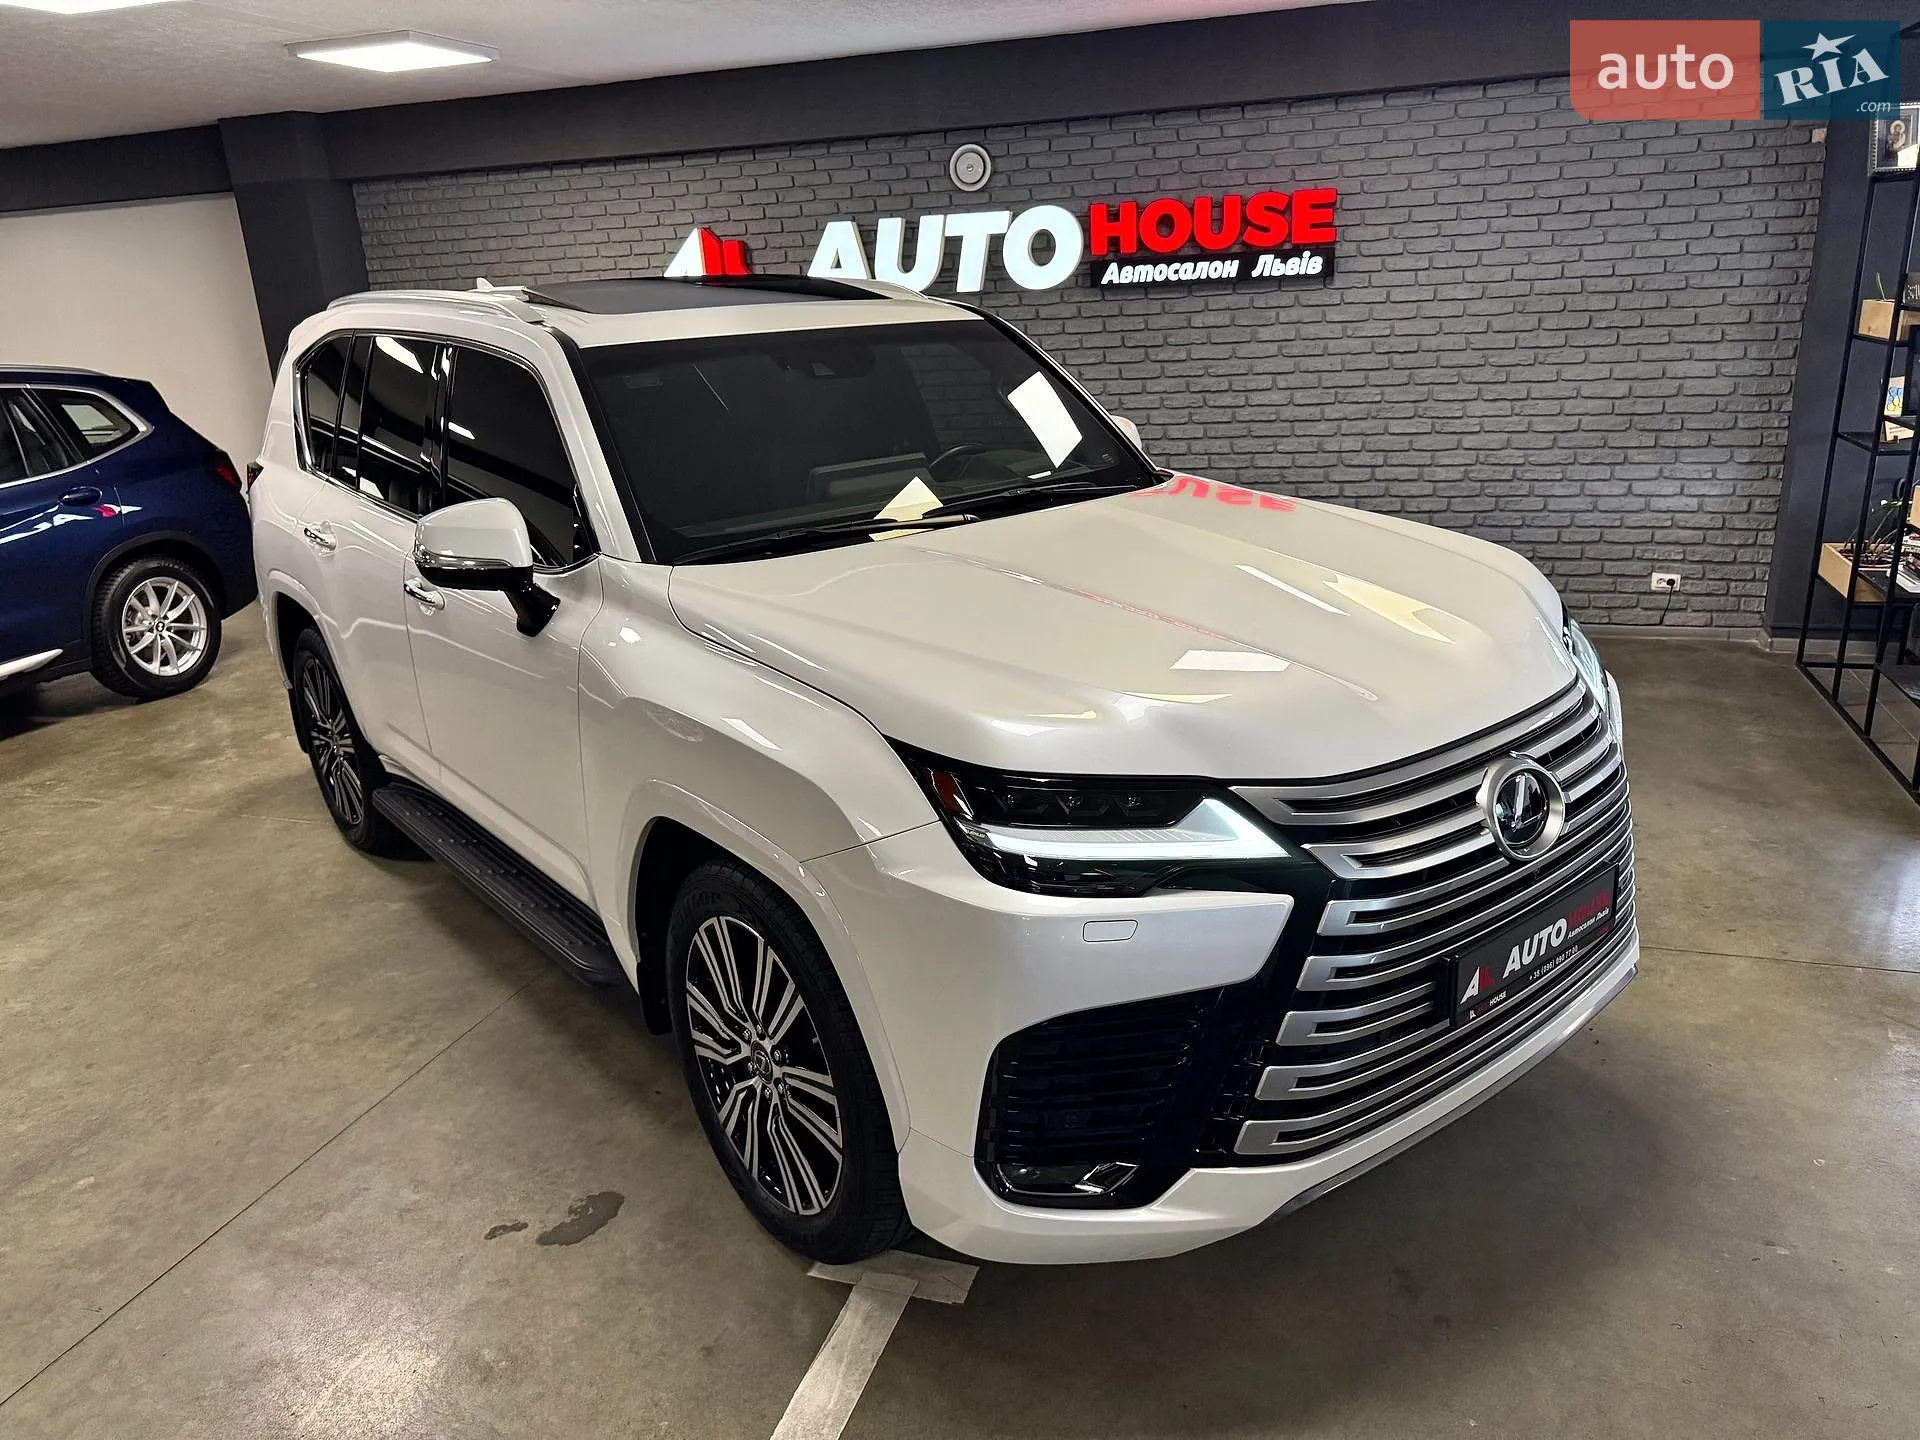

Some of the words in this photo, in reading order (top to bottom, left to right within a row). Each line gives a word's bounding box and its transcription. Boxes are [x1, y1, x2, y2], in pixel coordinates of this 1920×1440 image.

[807, 204, 1085, 293] AUTO
[1089, 188, 1338, 256] HOUSE
[1100, 259, 1240, 285] Автосалон
[1251, 250, 1324, 278] Львів
[1502, 917, 1568, 979] AUTO
